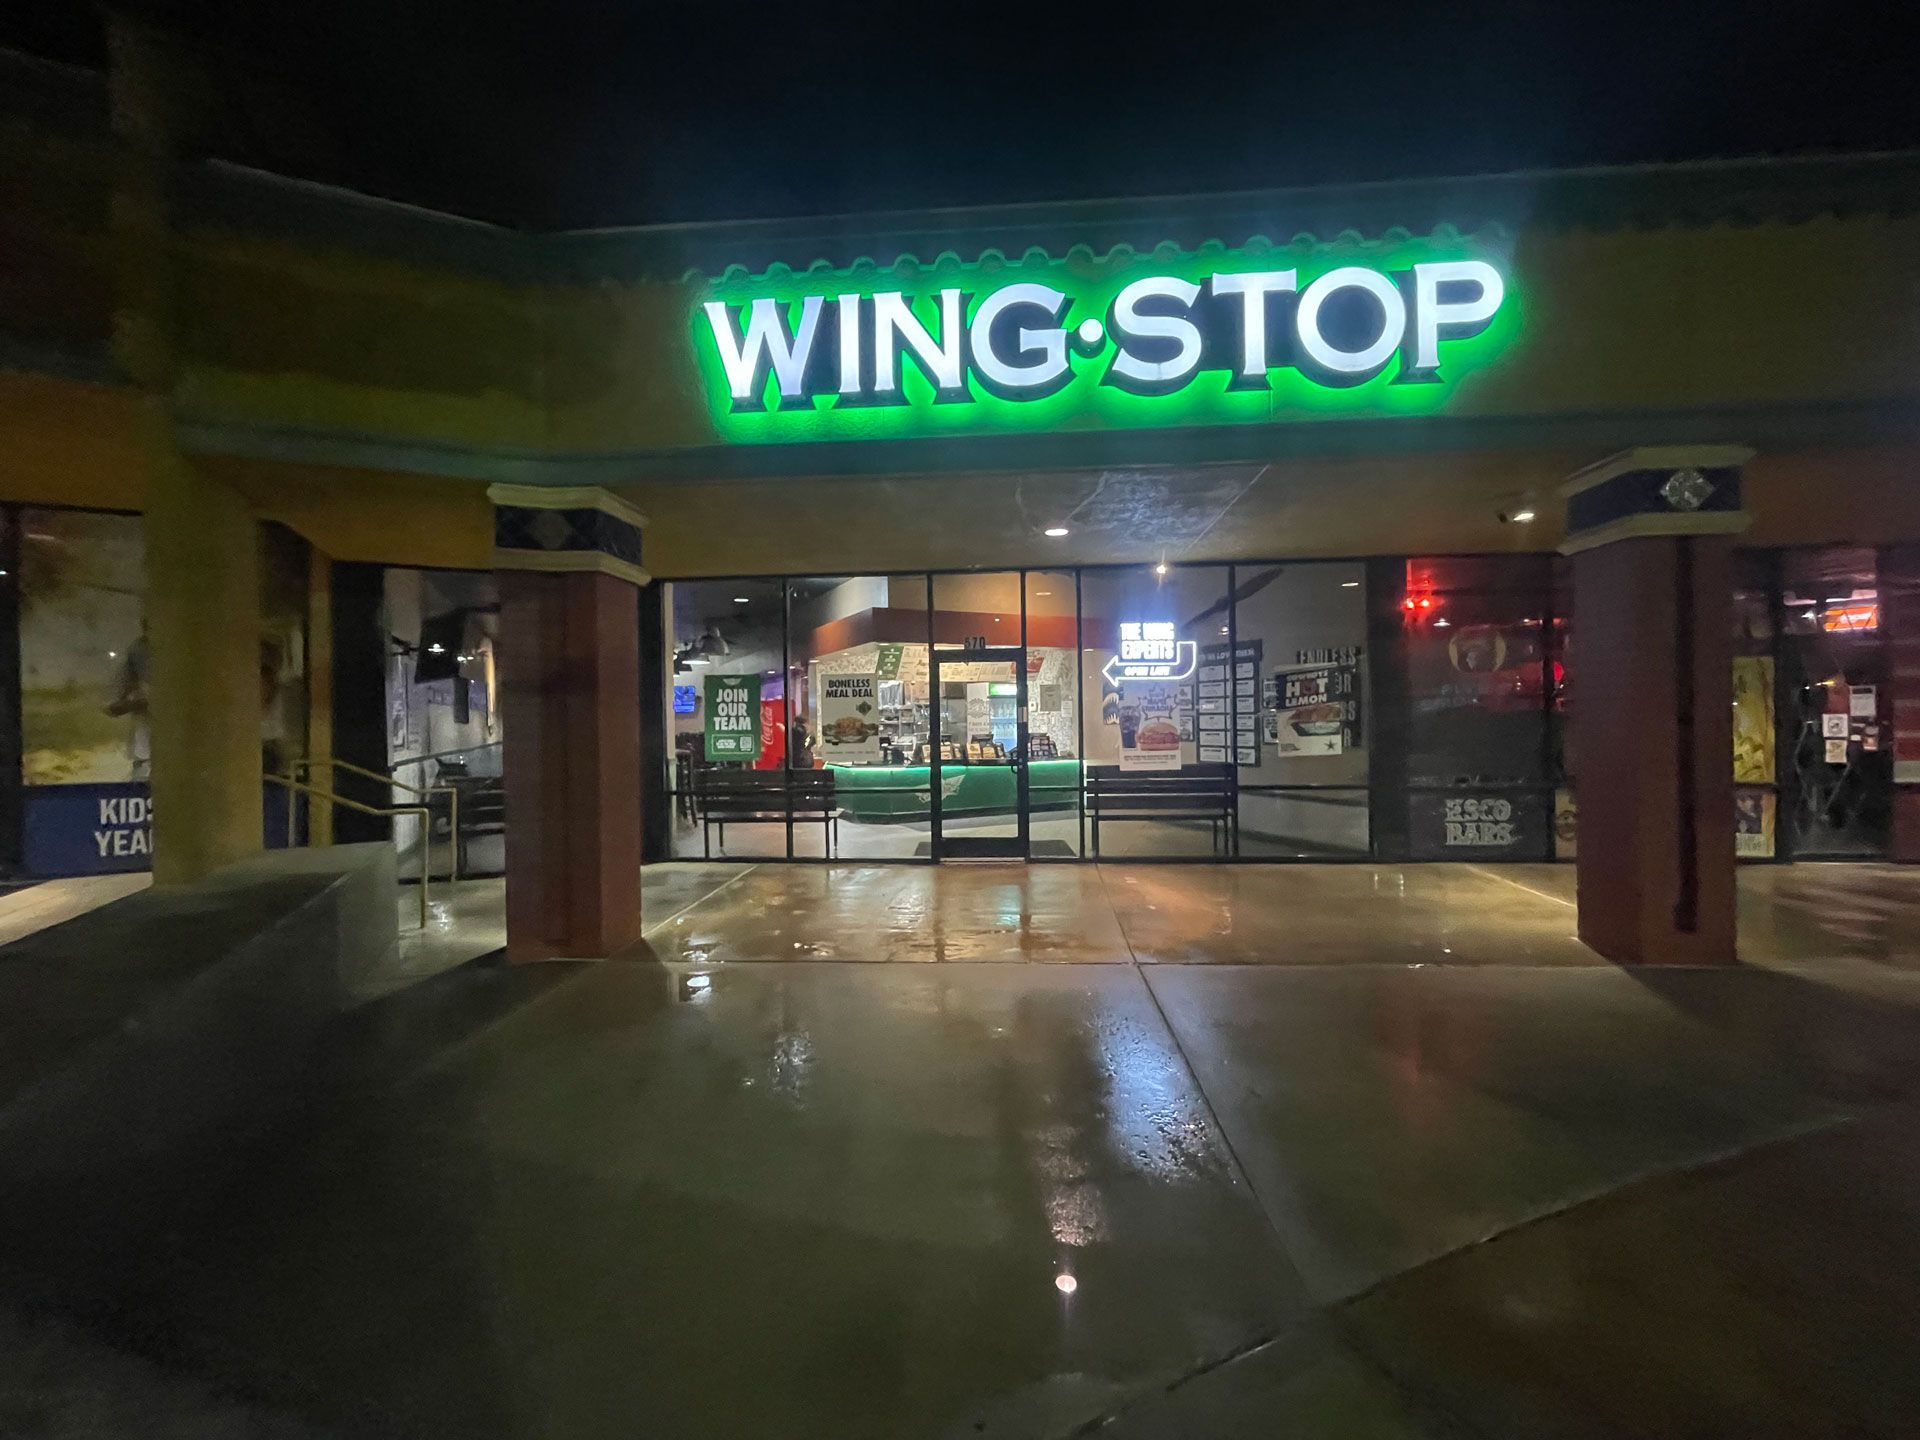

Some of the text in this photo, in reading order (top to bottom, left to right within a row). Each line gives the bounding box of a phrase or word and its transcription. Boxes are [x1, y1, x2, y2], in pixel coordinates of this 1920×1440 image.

[1120, 622, 1141, 640] THE
[965, 636, 986, 649] 570
[828, 678, 871, 689] BONELESS
[1286, 677, 1329, 698] HOT
[716, 688, 748, 703] JOIN
[826, 687, 874, 698] MEAL DEAL
[1285, 692, 1328, 708] LEMON
[717, 702, 748, 717] OUR
[713, 716, 752, 731] TEAM
[1446, 798, 1511, 822] ESCO
[1446, 822, 1516, 846] BARS
[94, 828, 153, 857] YEA
